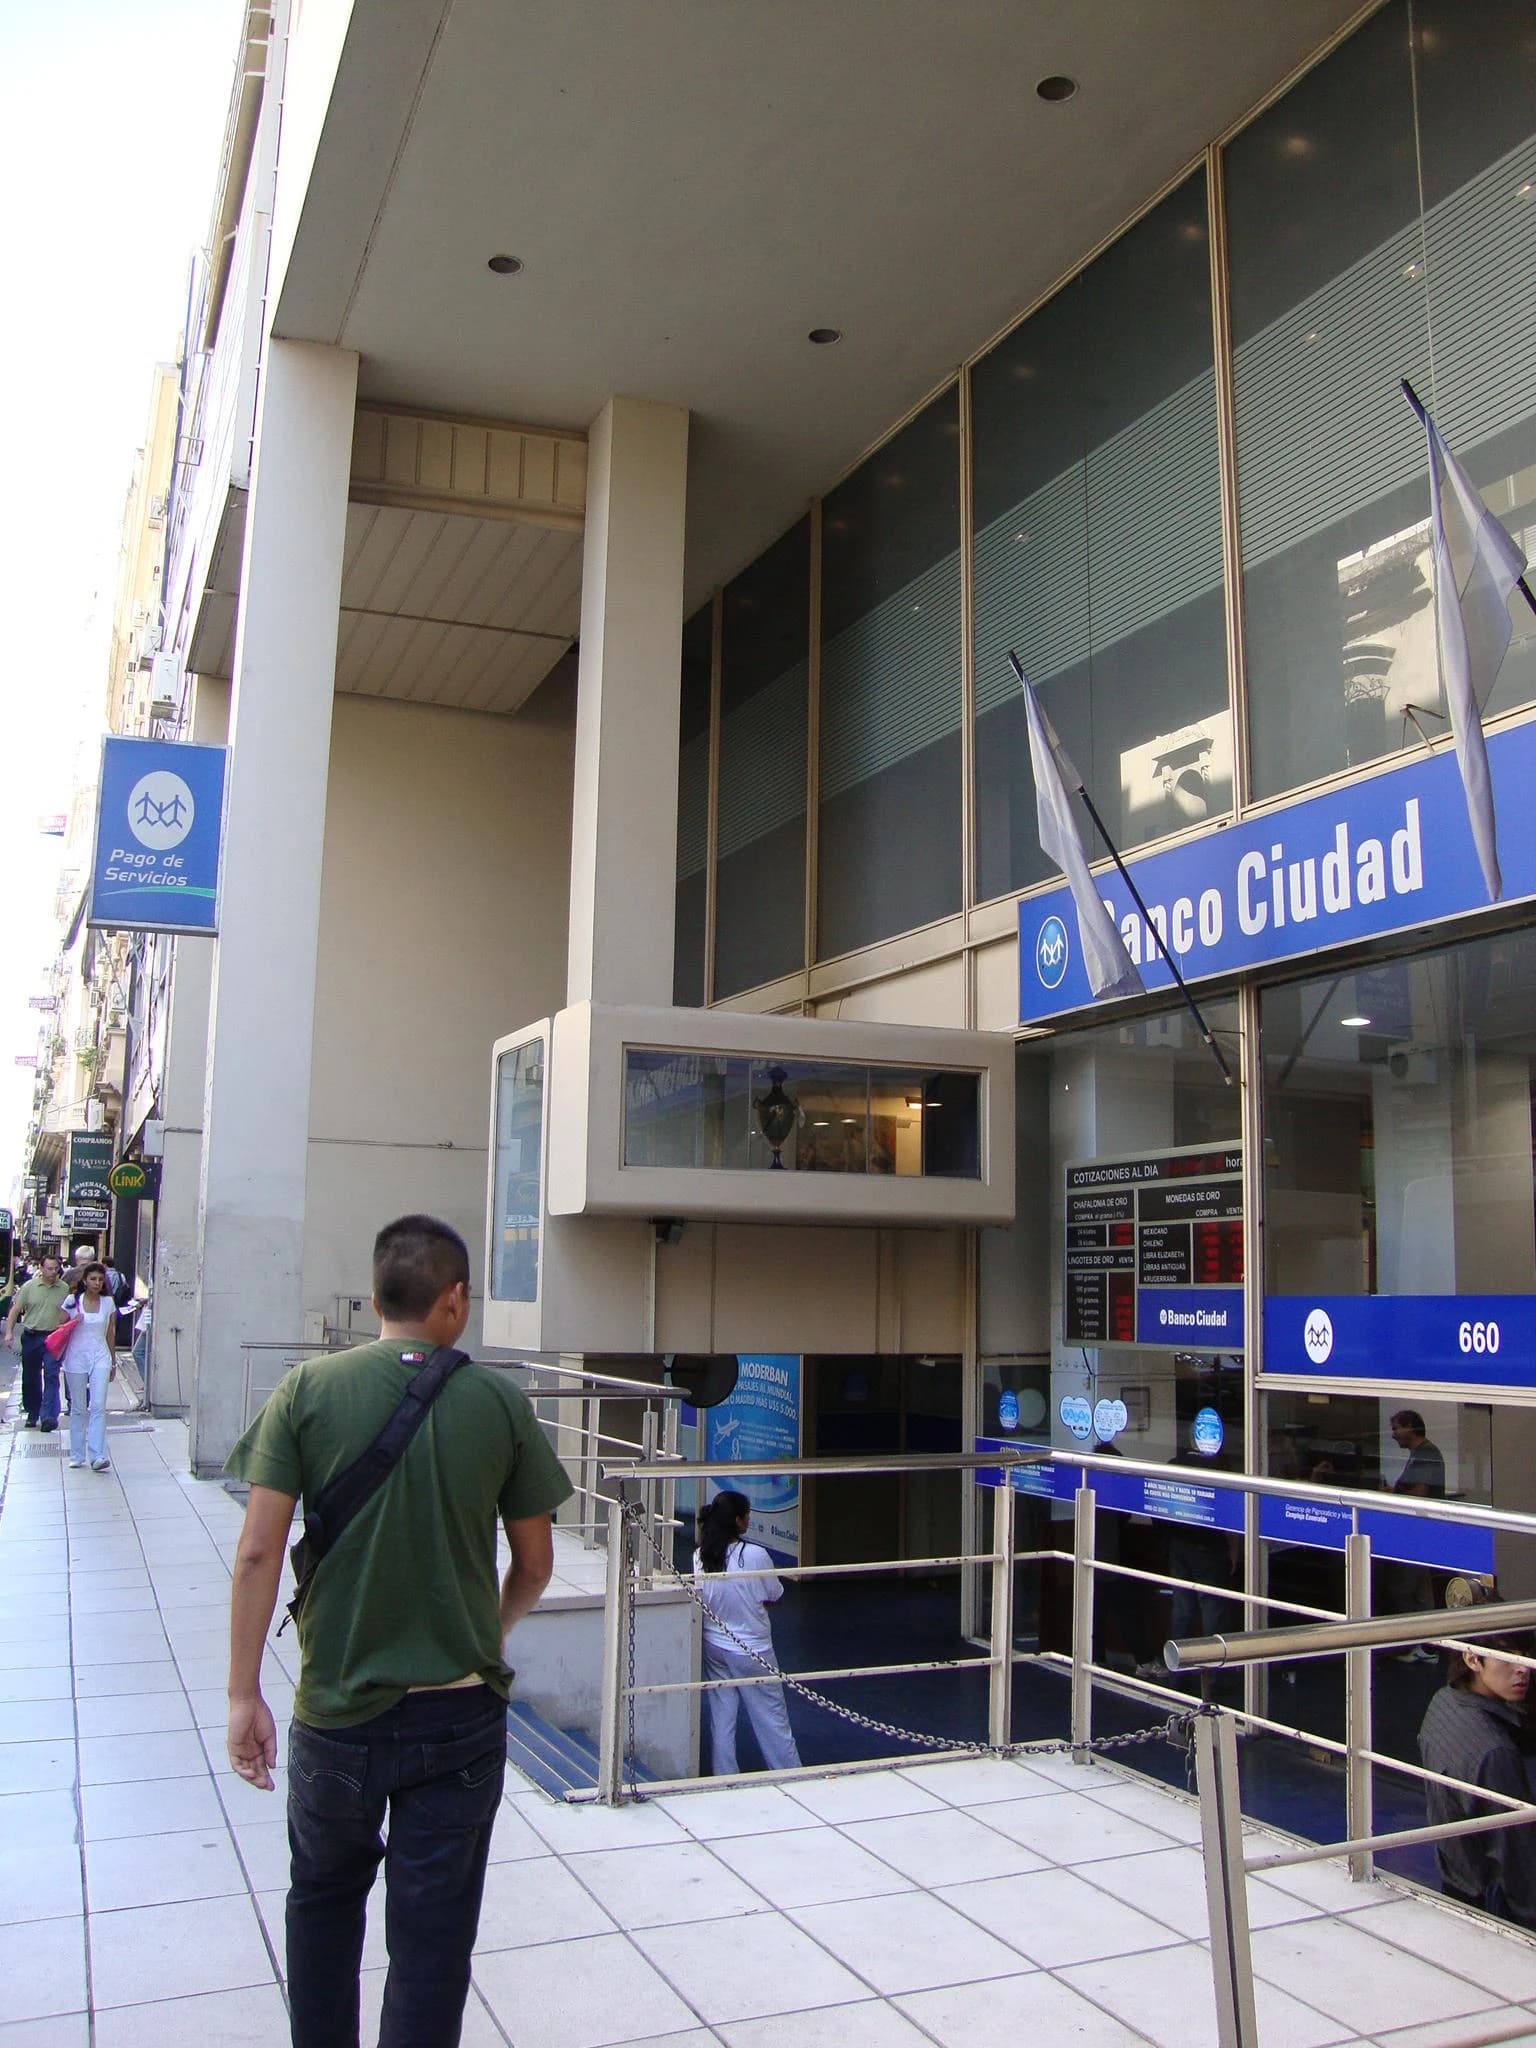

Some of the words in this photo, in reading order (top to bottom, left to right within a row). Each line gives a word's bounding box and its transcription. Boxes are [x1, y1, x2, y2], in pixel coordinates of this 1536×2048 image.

[110, 849, 157, 867] Pago
[163, 854, 184, 867] de
[104, 867, 187, 886] Servicios
[1103, 889, 1223, 965] anco
[1237, 798, 1423, 936] Ciudad
[73, 1136, 113, 1145] COMPRAMOS
[115, 1172, 144, 1187] LINK
[1073, 1167, 1130, 1183] COTIZACIONES
[1132, 1167, 1142, 1178] AL
[71, 1181, 111, 1195] ESMERALDA
[80, 1188, 101, 1197] 632
[1106, 1198, 1115, 1207] DE
[1115, 1197, 1128, 1206] ORO
[1165, 1192, 1195, 1203] MONEDAS
[1196, 1191, 1205, 1201] DE
[1206, 1190, 1220, 1200] ORO
[1195, 1208, 1218, 1217] COMPRA
[1067, 1256, 1093, 1265] LINGOTES
[1093, 1255, 1101, 1264] DE
[1101, 1255, 1114, 1264] ORO
[1143, 1251, 1157, 1259] LIBRA
[1143, 1263, 1160, 1271] LIBRAS
[1168, 1309, 1195, 1326] Banco
[1196, 1310, 1227, 1326] Ciudad
[1459, 1321, 1499, 1354] 660
[741, 1363, 789, 1386] MODERBAN
[759, 1383, 767, 1394] AL
[1305, 1513, 1328, 1523] Esmeralda
